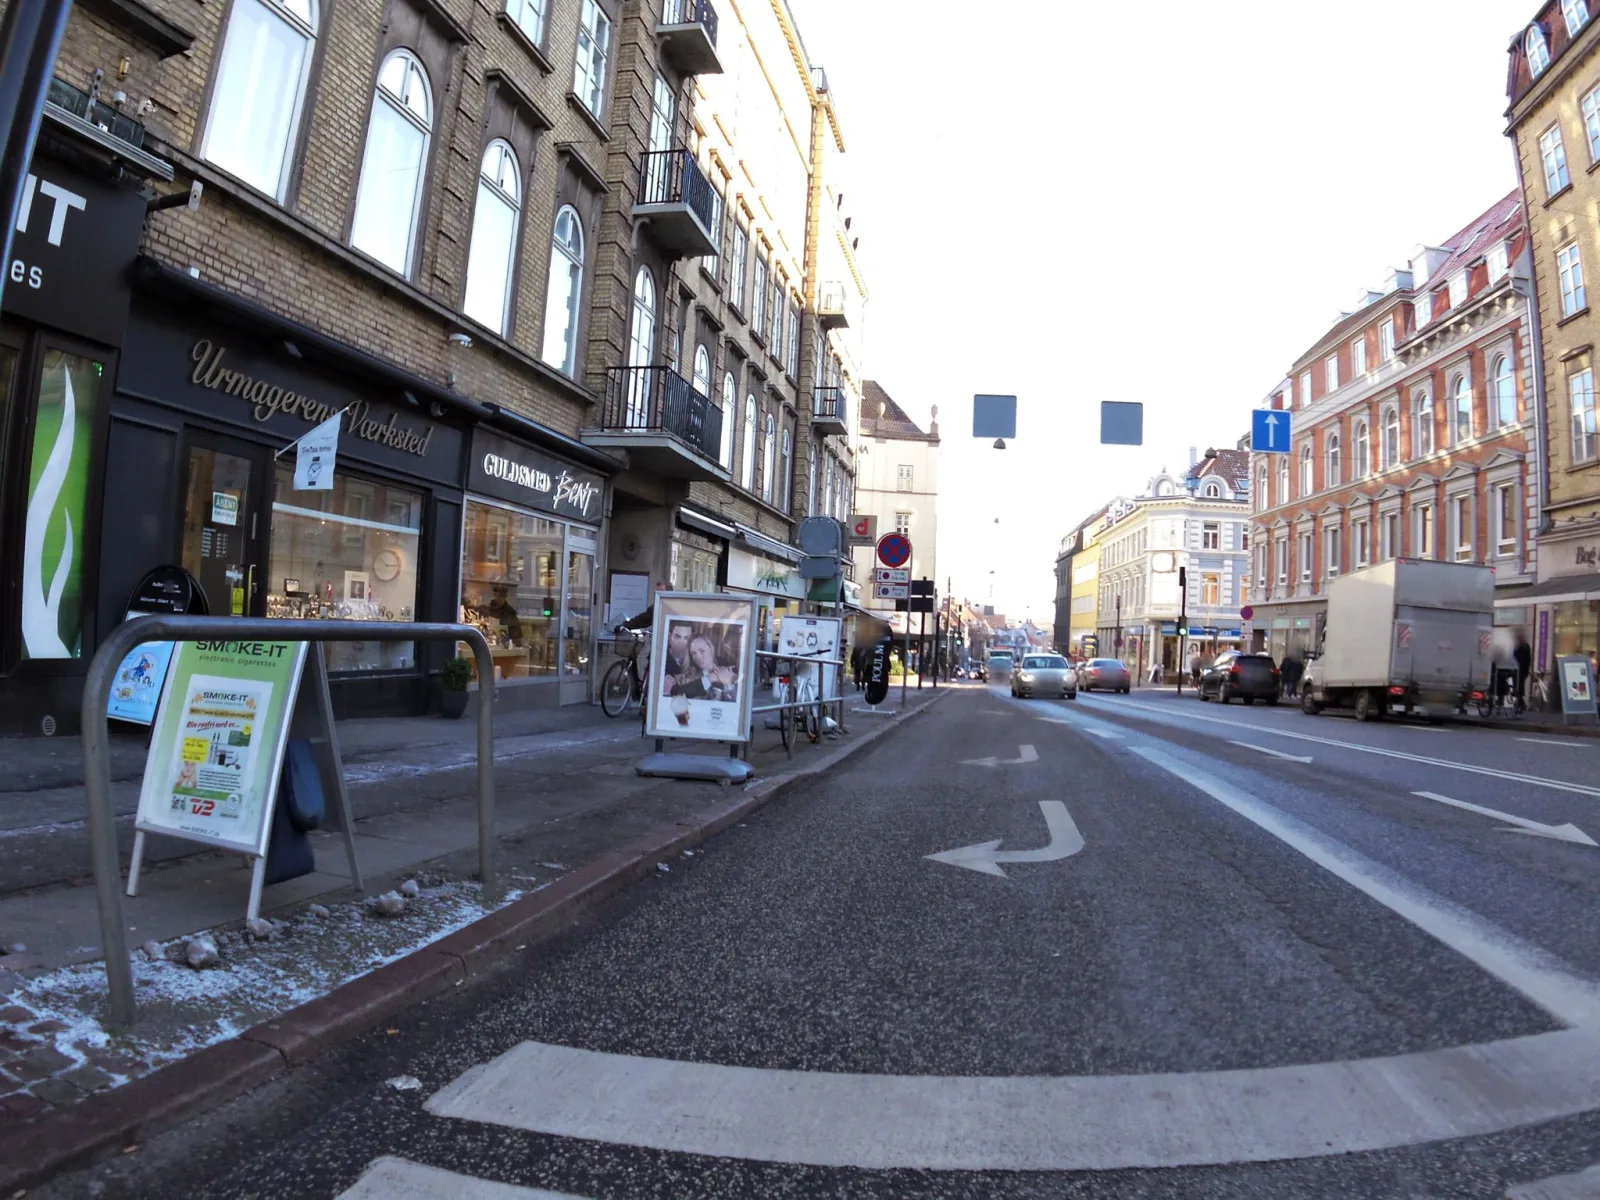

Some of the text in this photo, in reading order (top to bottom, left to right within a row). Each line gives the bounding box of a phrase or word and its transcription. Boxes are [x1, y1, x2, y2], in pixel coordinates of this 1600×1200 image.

[191, 339, 435, 457] Urmagerens Værksted
[483, 453, 552, 493] GULDSMED
[1575, 546, 1597, 569] Bog
[196, 641, 287, 658] SMOKE-IT
[199, 655, 277, 668] electronic cigarettes
[872, 657, 885, 683] POUL
[203, 692, 248, 702] SMOKE-IT
